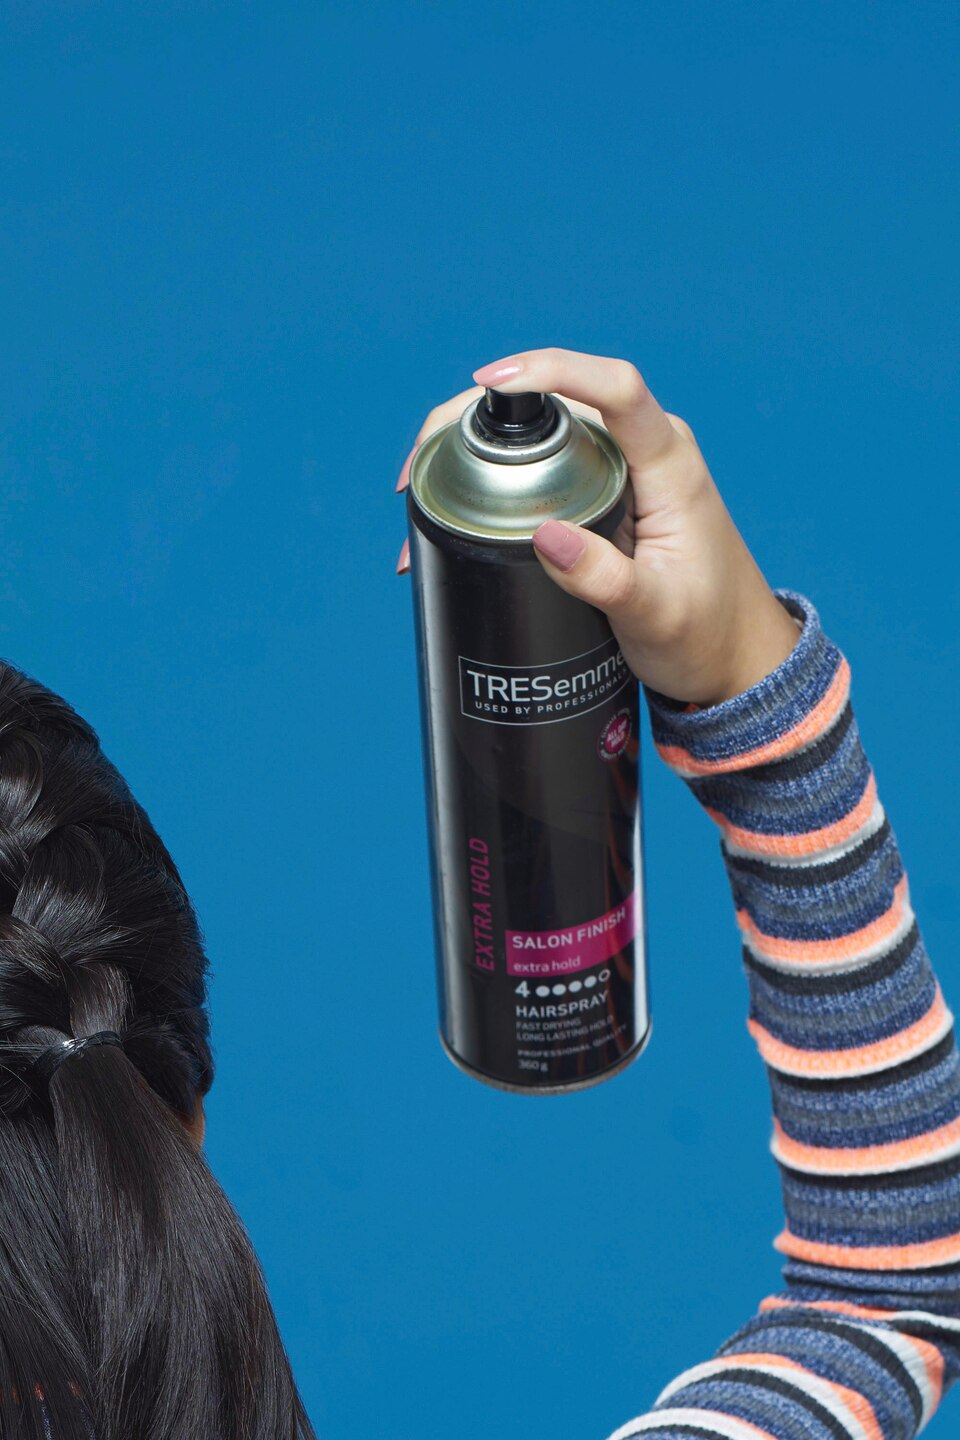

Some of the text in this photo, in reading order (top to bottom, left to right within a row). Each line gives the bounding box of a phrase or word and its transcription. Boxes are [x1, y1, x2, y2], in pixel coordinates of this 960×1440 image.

[475, 701, 508, 714] USED
[515, 706, 530, 714] BY
[469, 838, 494, 971] EXTRA HOLD
[512, 907, 625, 949] SALON FINISH
[514, 956, 581, 972] extra hold
[515, 981, 530, 998] 4
[516, 989, 608, 1018] HAIRSPRAY
[516, 1017, 581, 1031] FAST DRYING
[517, 1015, 614, 1041] LONG LASTING HOLD
[518, 1044, 590, 1057] PROFESSIONAL
